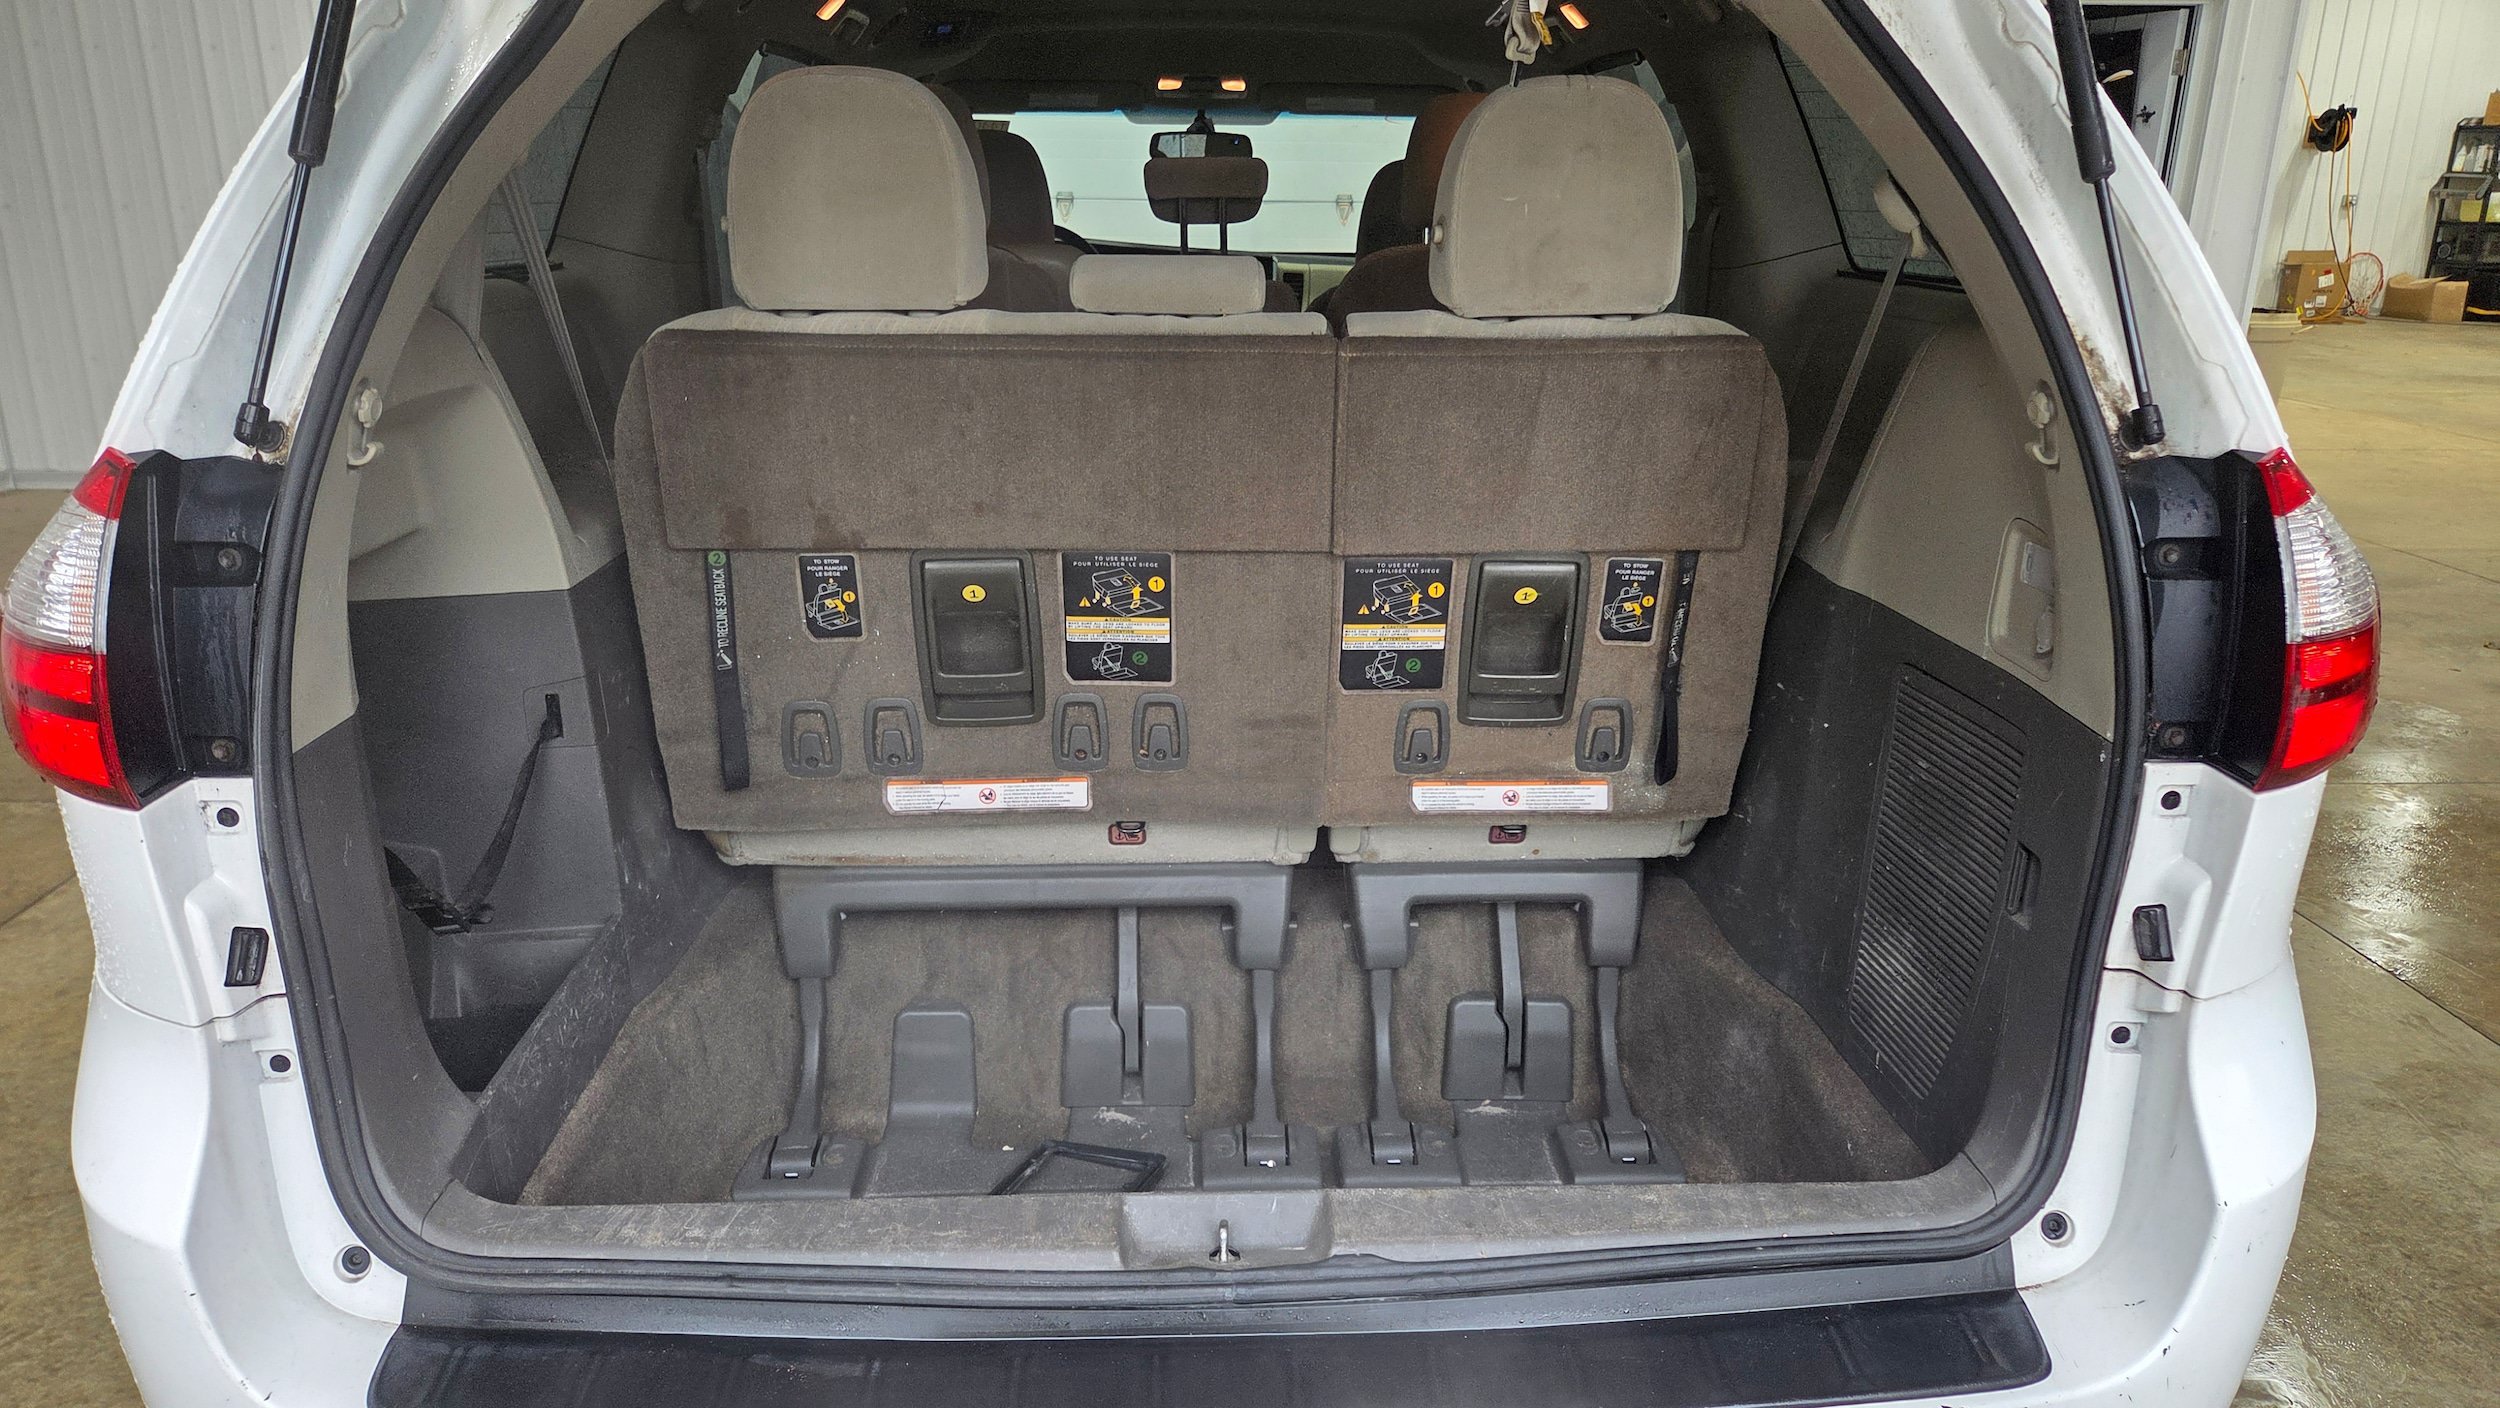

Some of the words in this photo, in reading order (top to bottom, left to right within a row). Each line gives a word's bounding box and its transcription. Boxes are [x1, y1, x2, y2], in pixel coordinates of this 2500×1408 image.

[712, 568, 728, 606] SEATBACK
[716, 607, 729, 637] RECLINE
[718, 638, 730, 648] TO
